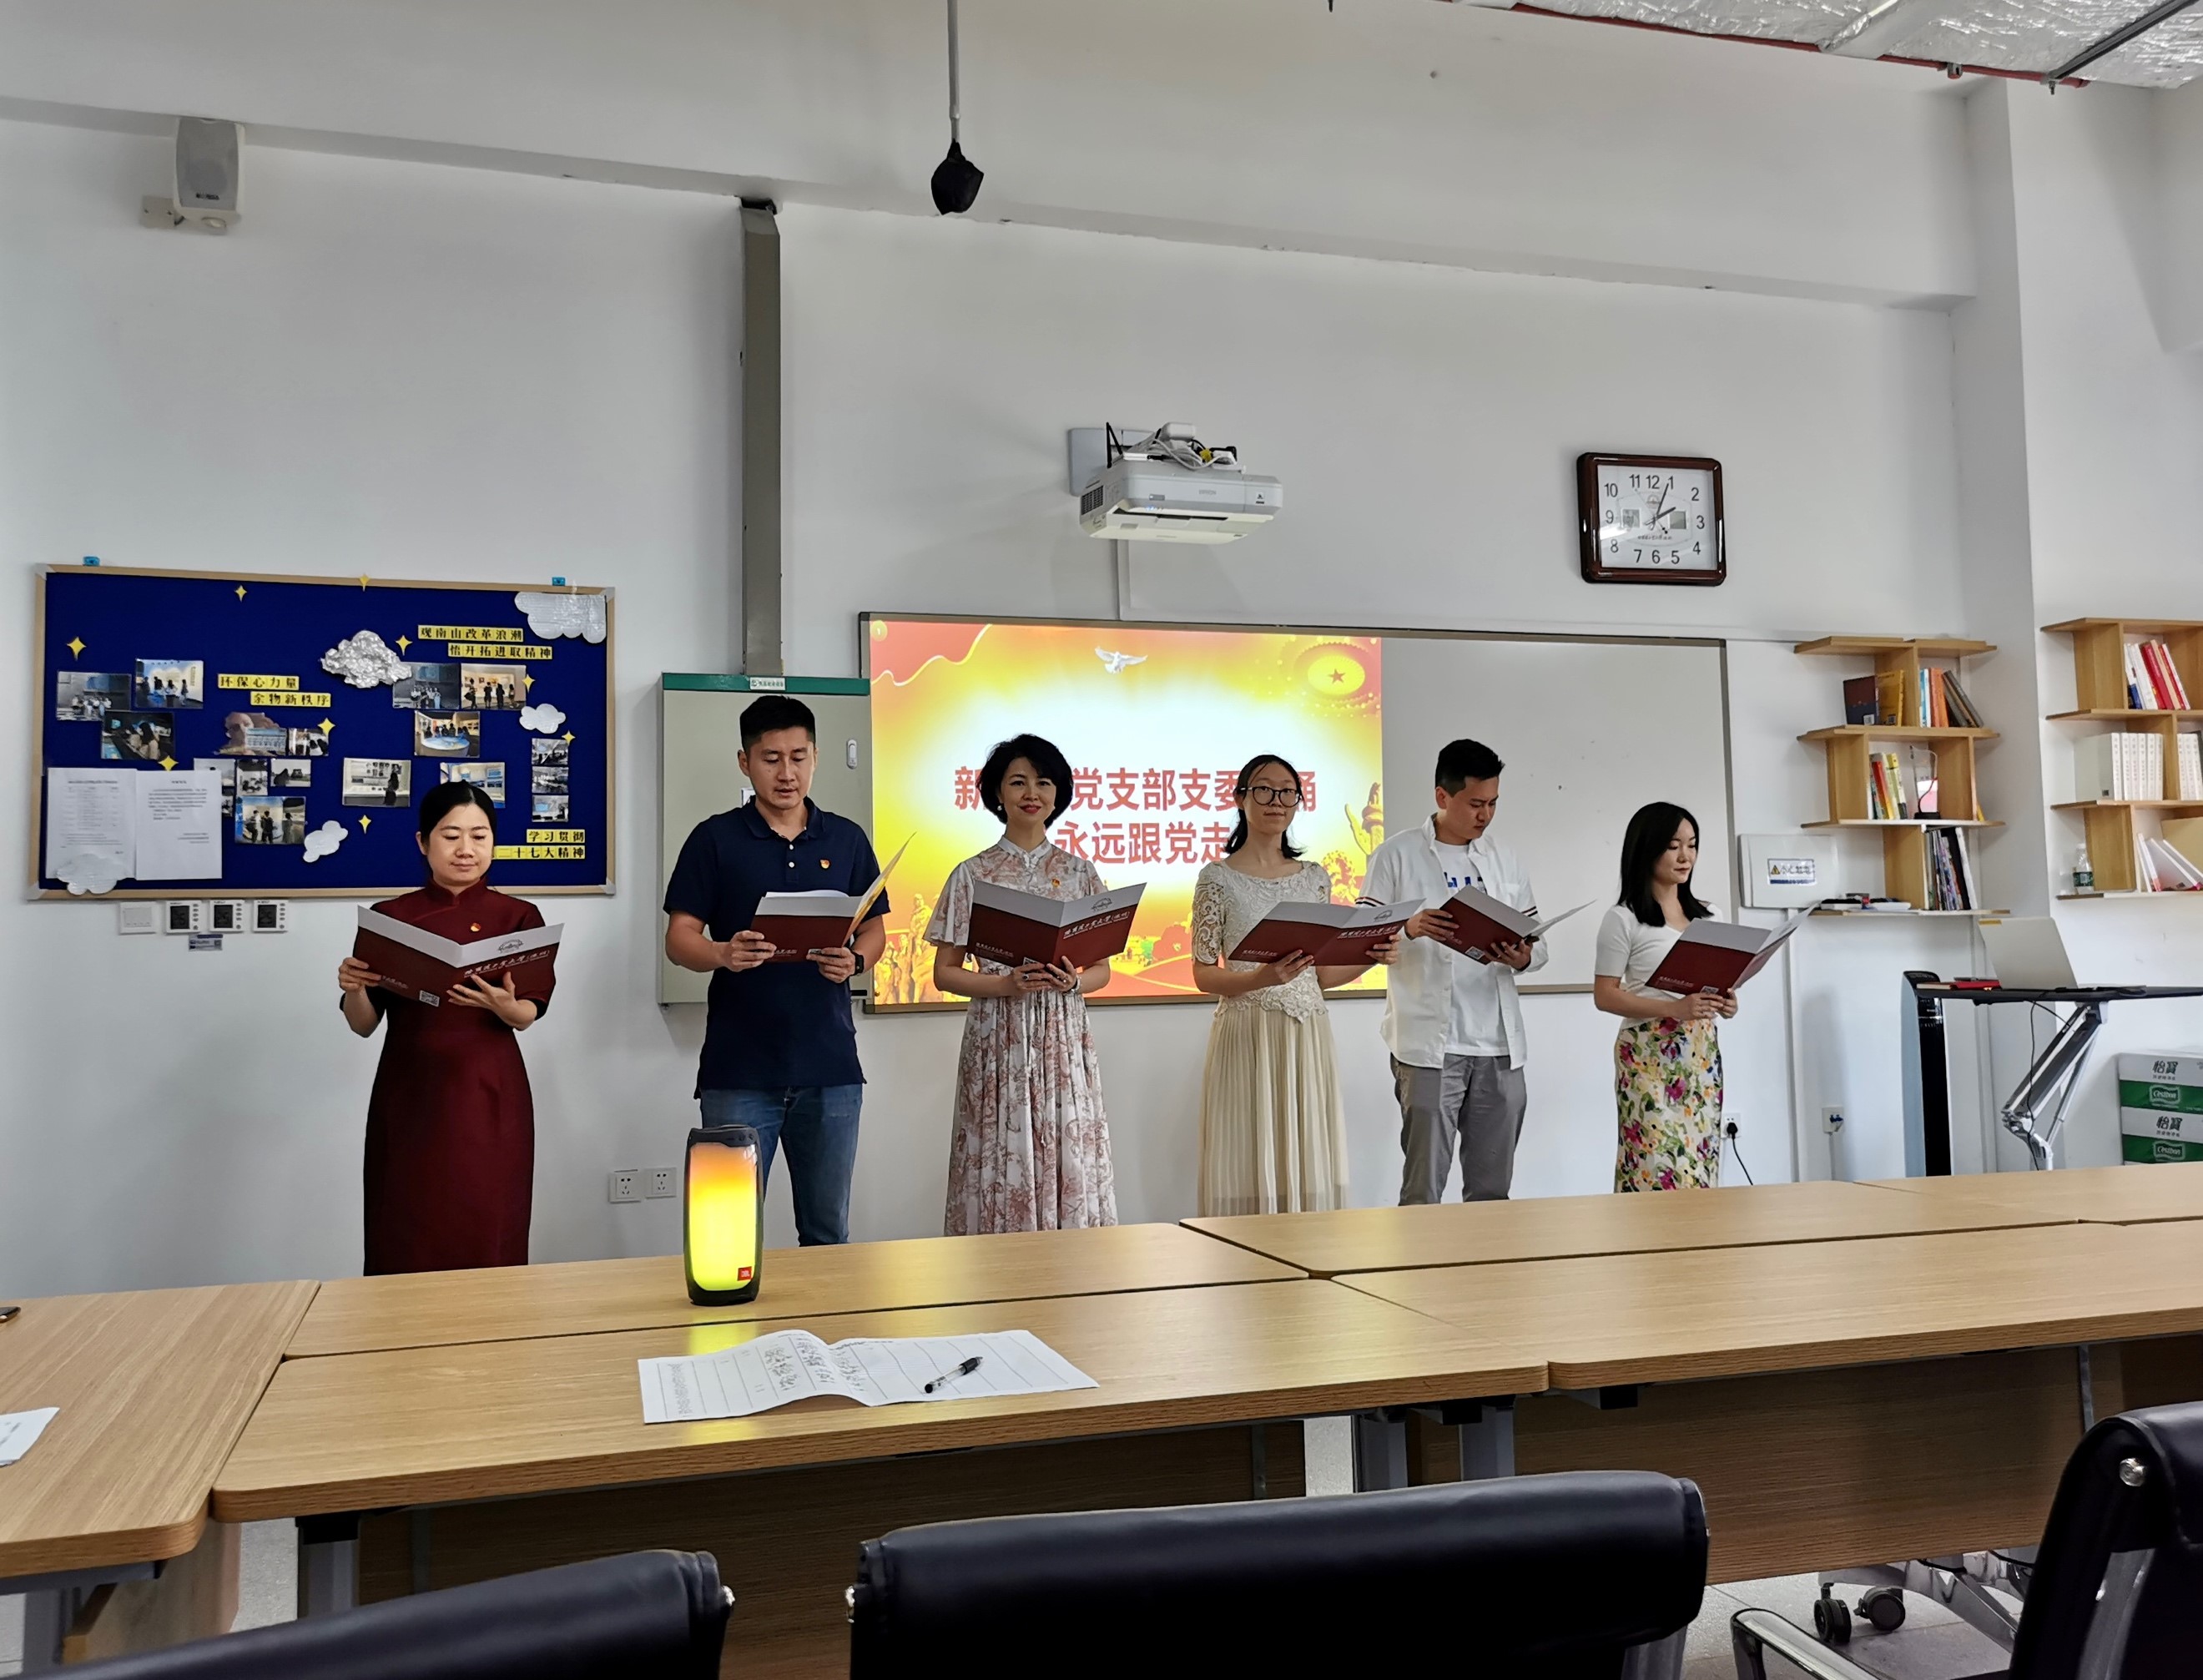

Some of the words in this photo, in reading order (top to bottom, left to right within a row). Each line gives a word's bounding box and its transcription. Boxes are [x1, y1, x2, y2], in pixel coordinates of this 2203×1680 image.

[1629, 474, 1641, 488] 11
[1646, 475, 1660, 489] 12
[1668, 476, 1675, 490] 1
[1604, 482, 1618, 497] 10
[1691, 487, 1699, 502] 2
[1606, 510, 1614, 524] 9
[1696, 515, 1705, 530] 3
[1611, 538, 1619, 553] 8
[1692, 541, 1701, 555] 4
[1634, 549, 1642, 563] 7
[1651, 550, 1660, 564] 6
[1671, 550, 1680, 564] 5
[421, 627, 522, 641] 观南山改革浪潮
[220, 675, 296, 689] 环保心力量
[528, 830, 584, 842] 学习贯彻
